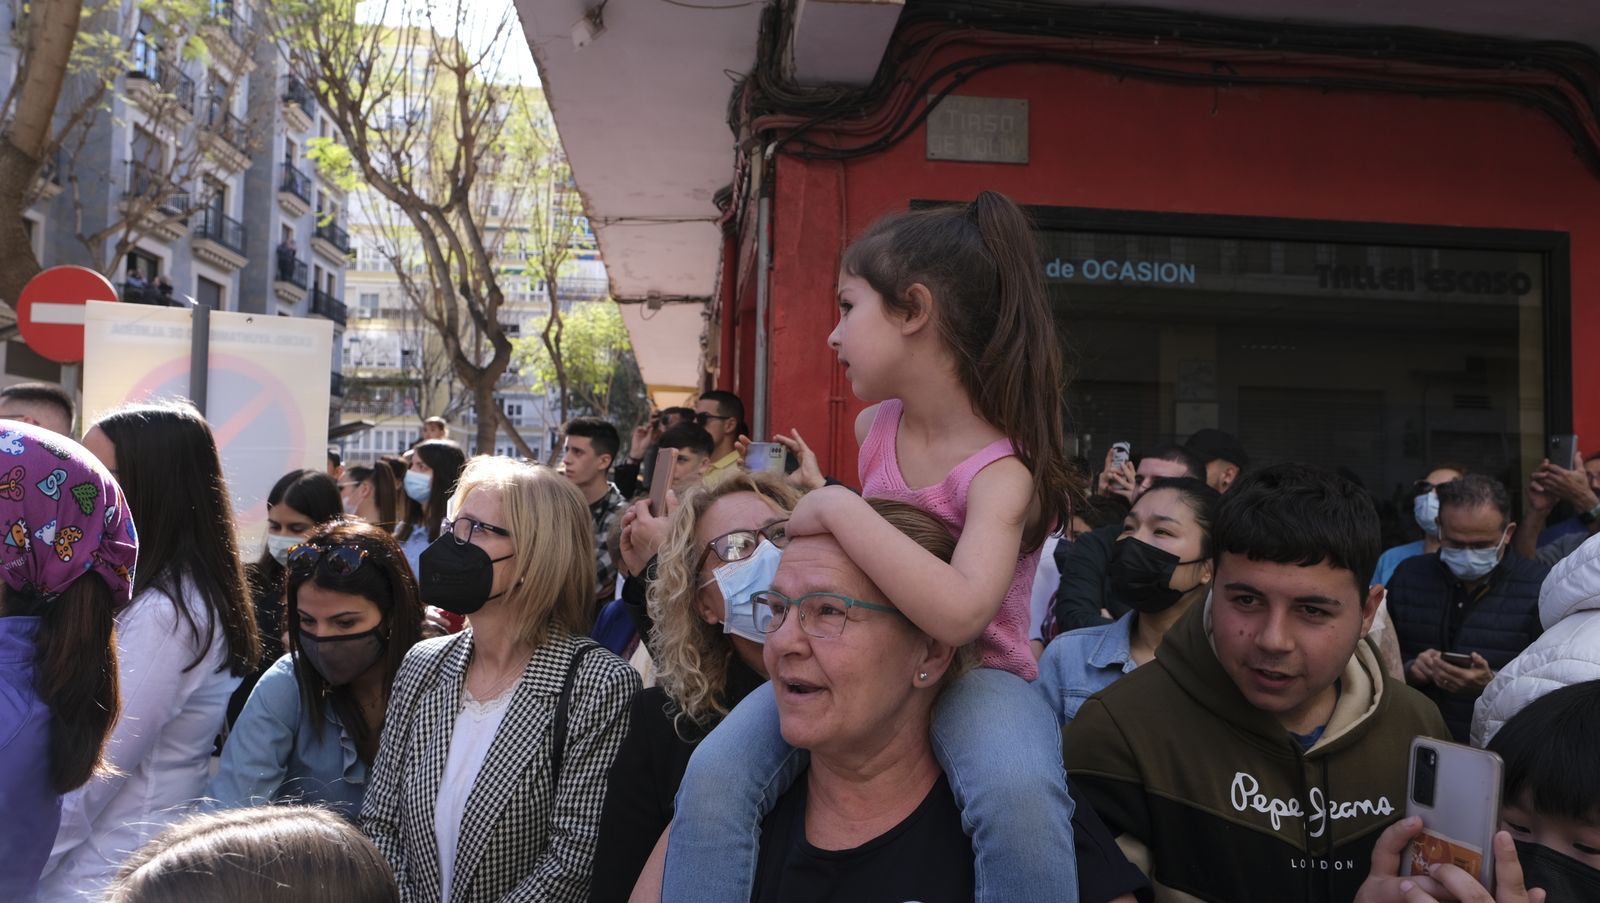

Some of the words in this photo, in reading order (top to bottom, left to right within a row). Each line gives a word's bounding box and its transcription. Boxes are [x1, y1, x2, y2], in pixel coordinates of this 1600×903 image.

[1046, 257, 1075, 278] de
[1082, 258, 1195, 284] OCASION
[1231, 772, 1304, 831] Pepe
[1305, 787, 1395, 838] Jeans
